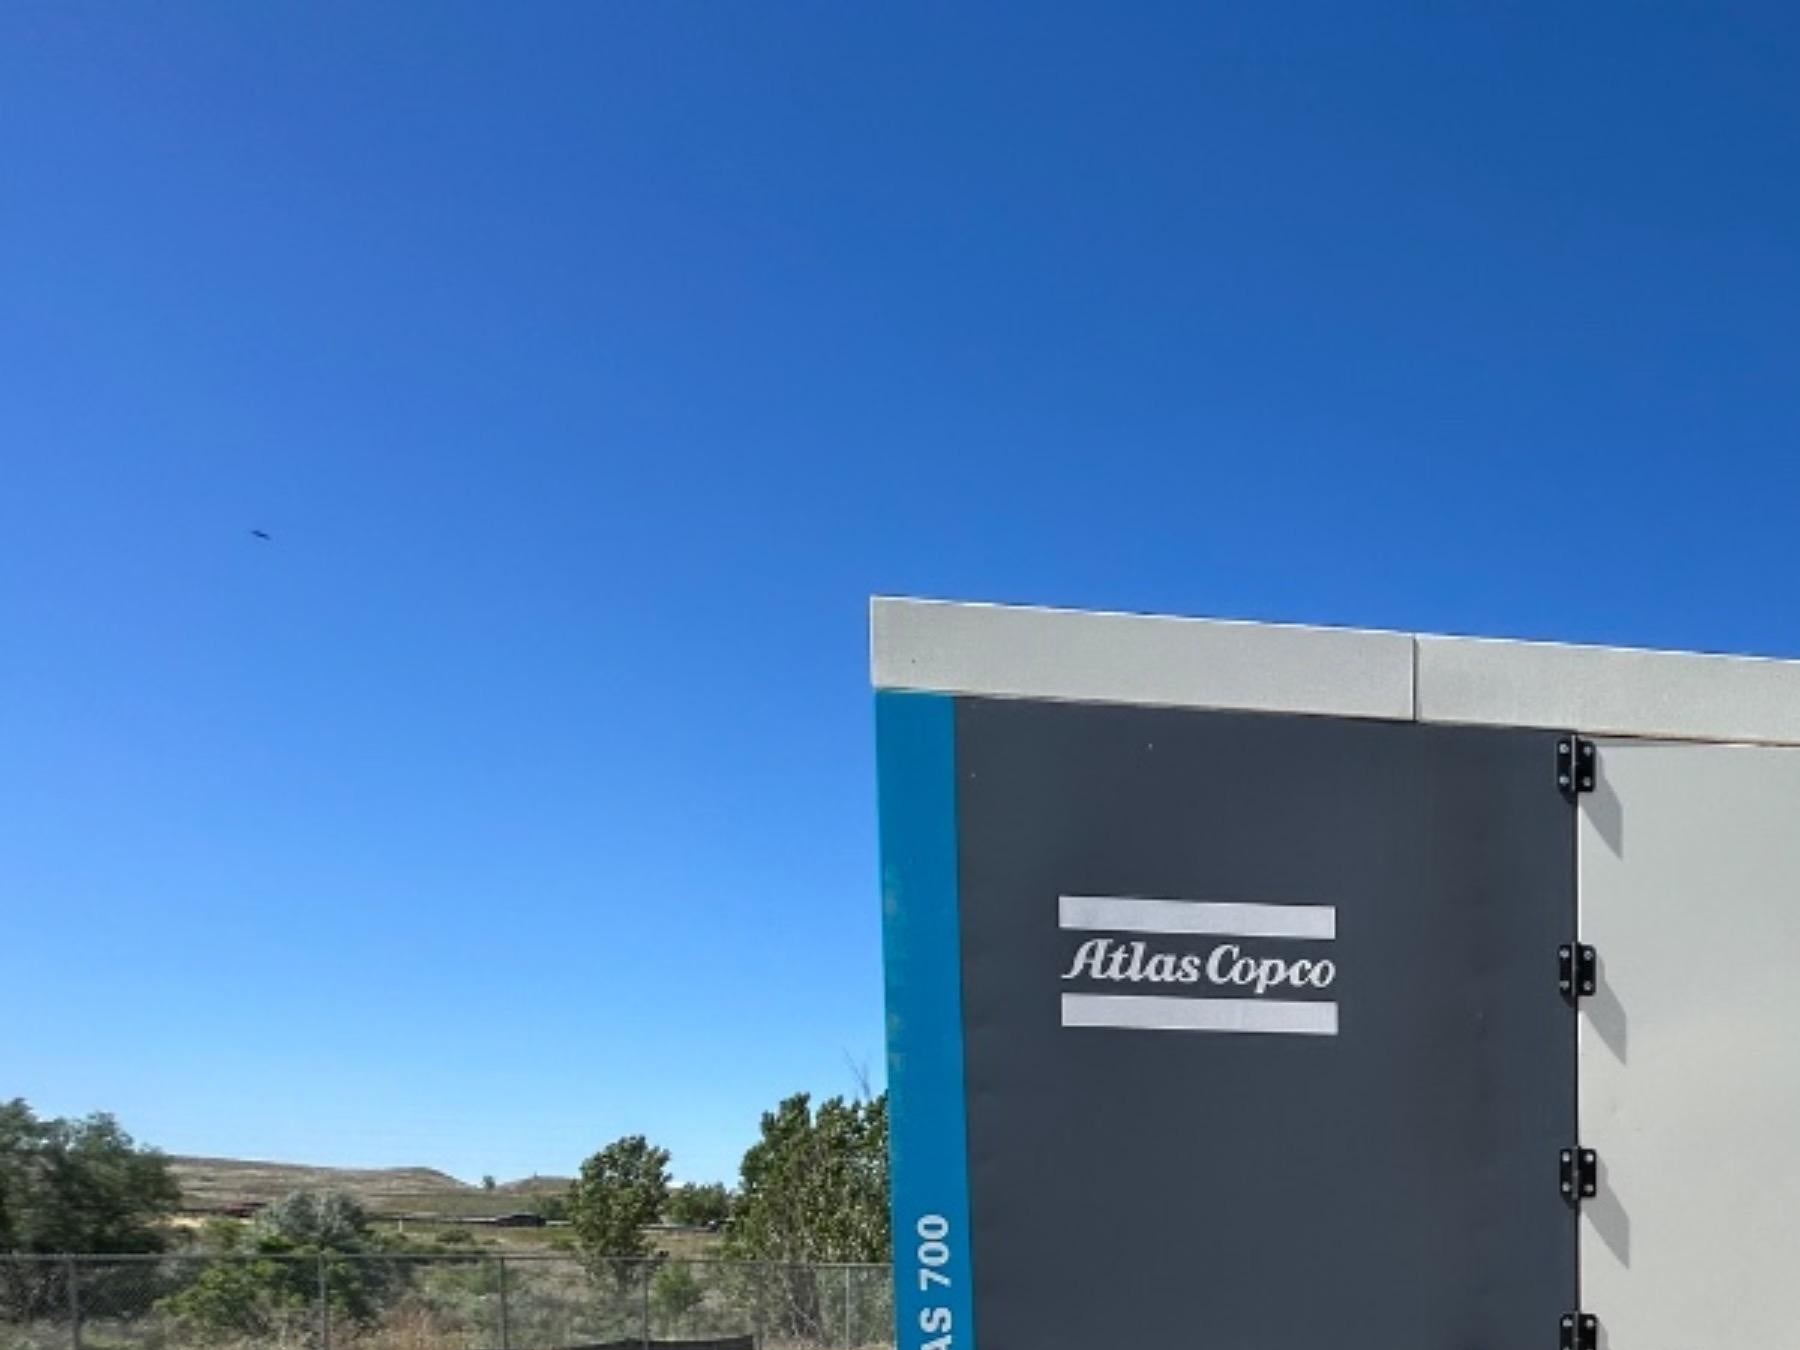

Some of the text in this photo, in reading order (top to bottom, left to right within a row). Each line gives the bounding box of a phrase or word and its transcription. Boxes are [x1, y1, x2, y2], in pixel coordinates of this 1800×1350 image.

[1061, 938, 1336, 994] Atlas Copco
[917, 1214, 951, 1292] 700
